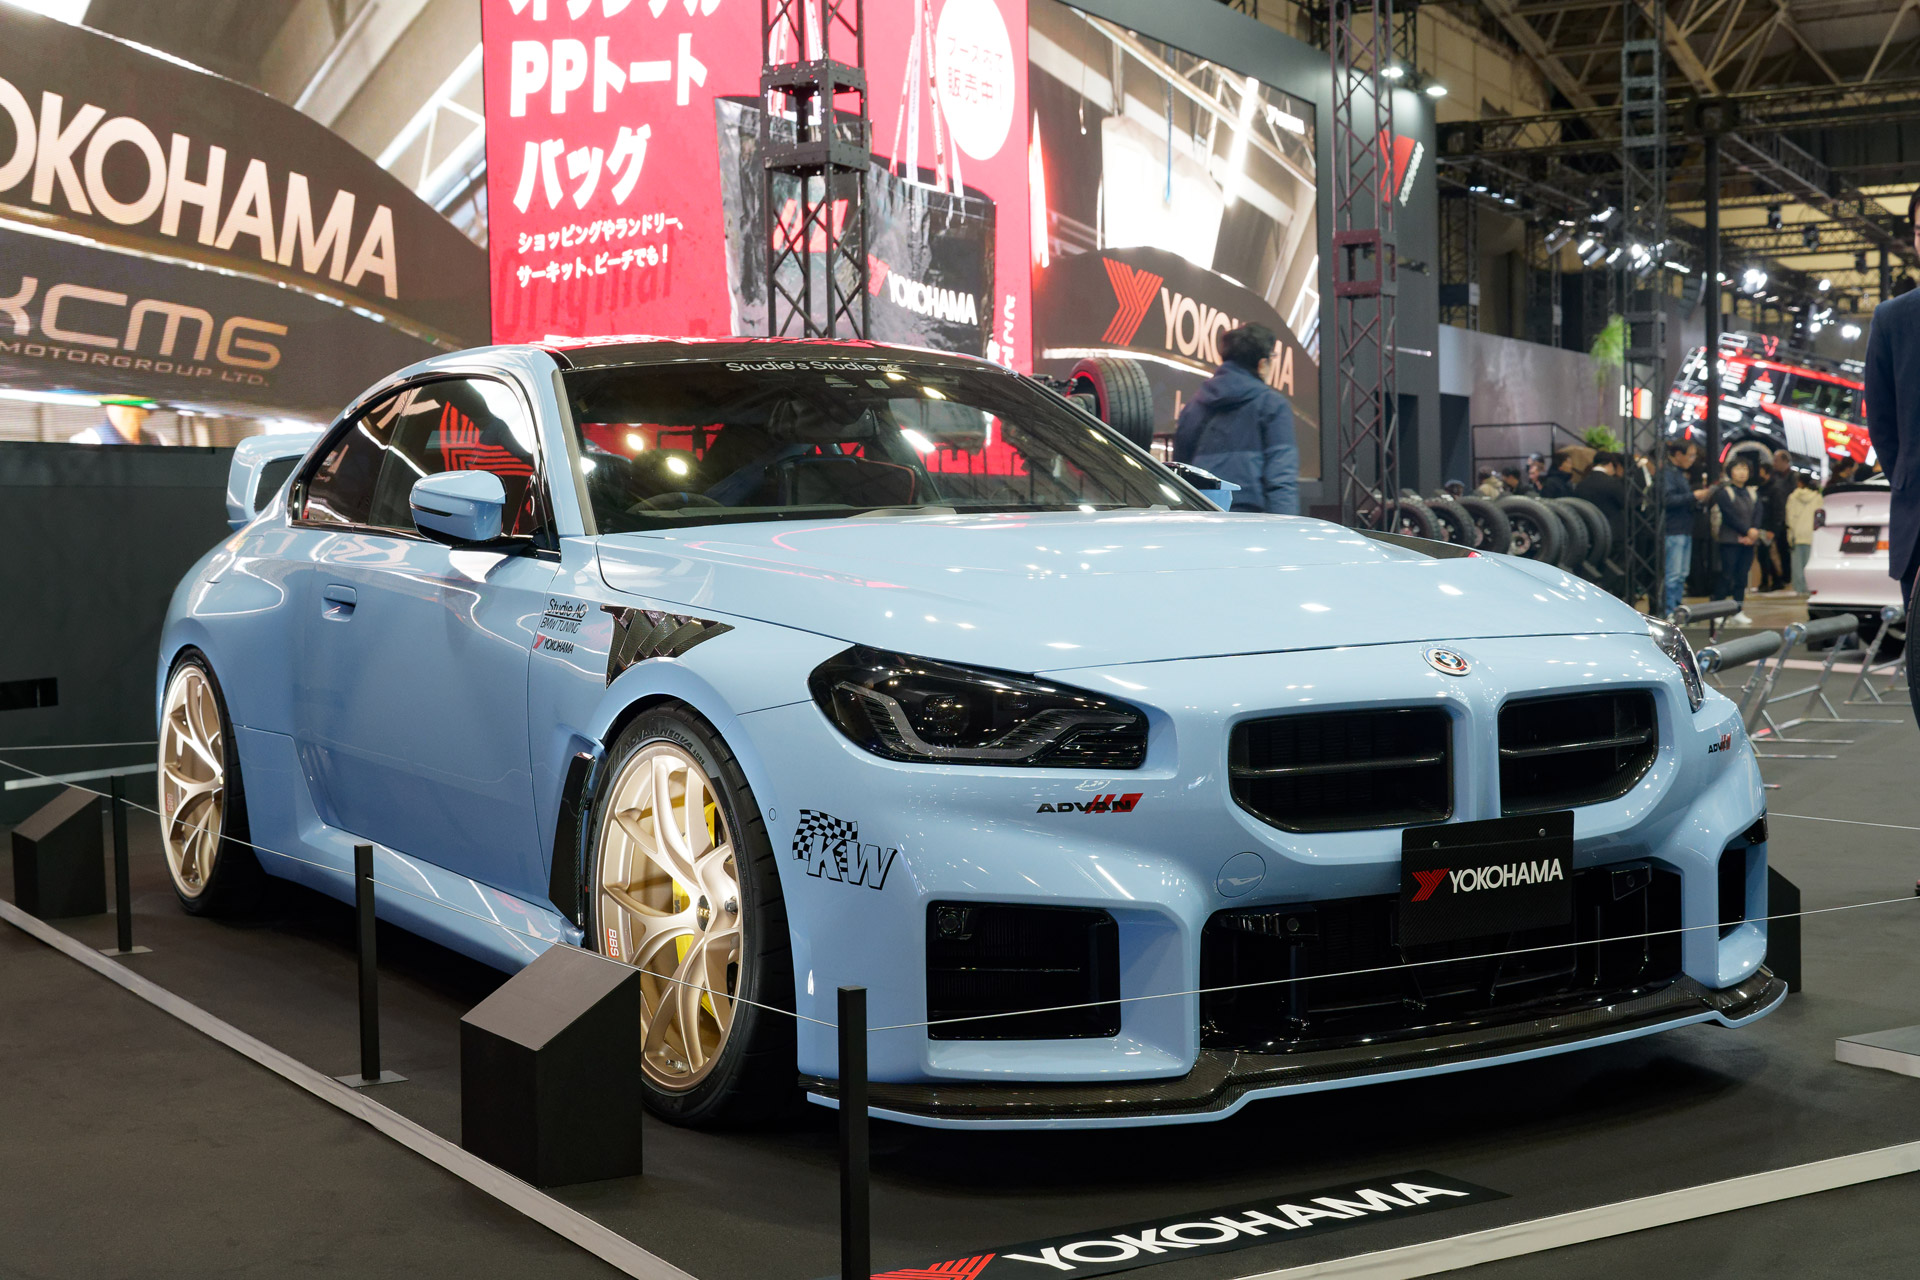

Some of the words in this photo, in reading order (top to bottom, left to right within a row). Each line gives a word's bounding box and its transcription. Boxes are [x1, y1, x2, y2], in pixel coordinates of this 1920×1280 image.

[509, 32, 709, 118] PPトート
[512, 123, 652, 214] バッグ
[517, 212, 684, 254] ショッピングやランドリー、
[887, 269, 978, 326] YOKOHAMA
[0, 340, 213, 378] MOTORGROUP
[221, 371, 270, 388] LTD.
[725, 360, 811, 373] Studie's
[809, 360, 877, 372] Studie
[547, 598, 573, 617] Studie
[543, 637, 575, 655] YOKOHAMA
[1036, 798, 1133, 814] ADVAN
[806, 832, 898, 891] KW
[1448, 858, 1564, 895] YOKOHAMA
[608, 927, 620, 958] BBS
[1002, 1181, 1470, 1271] YOKOHAMA
